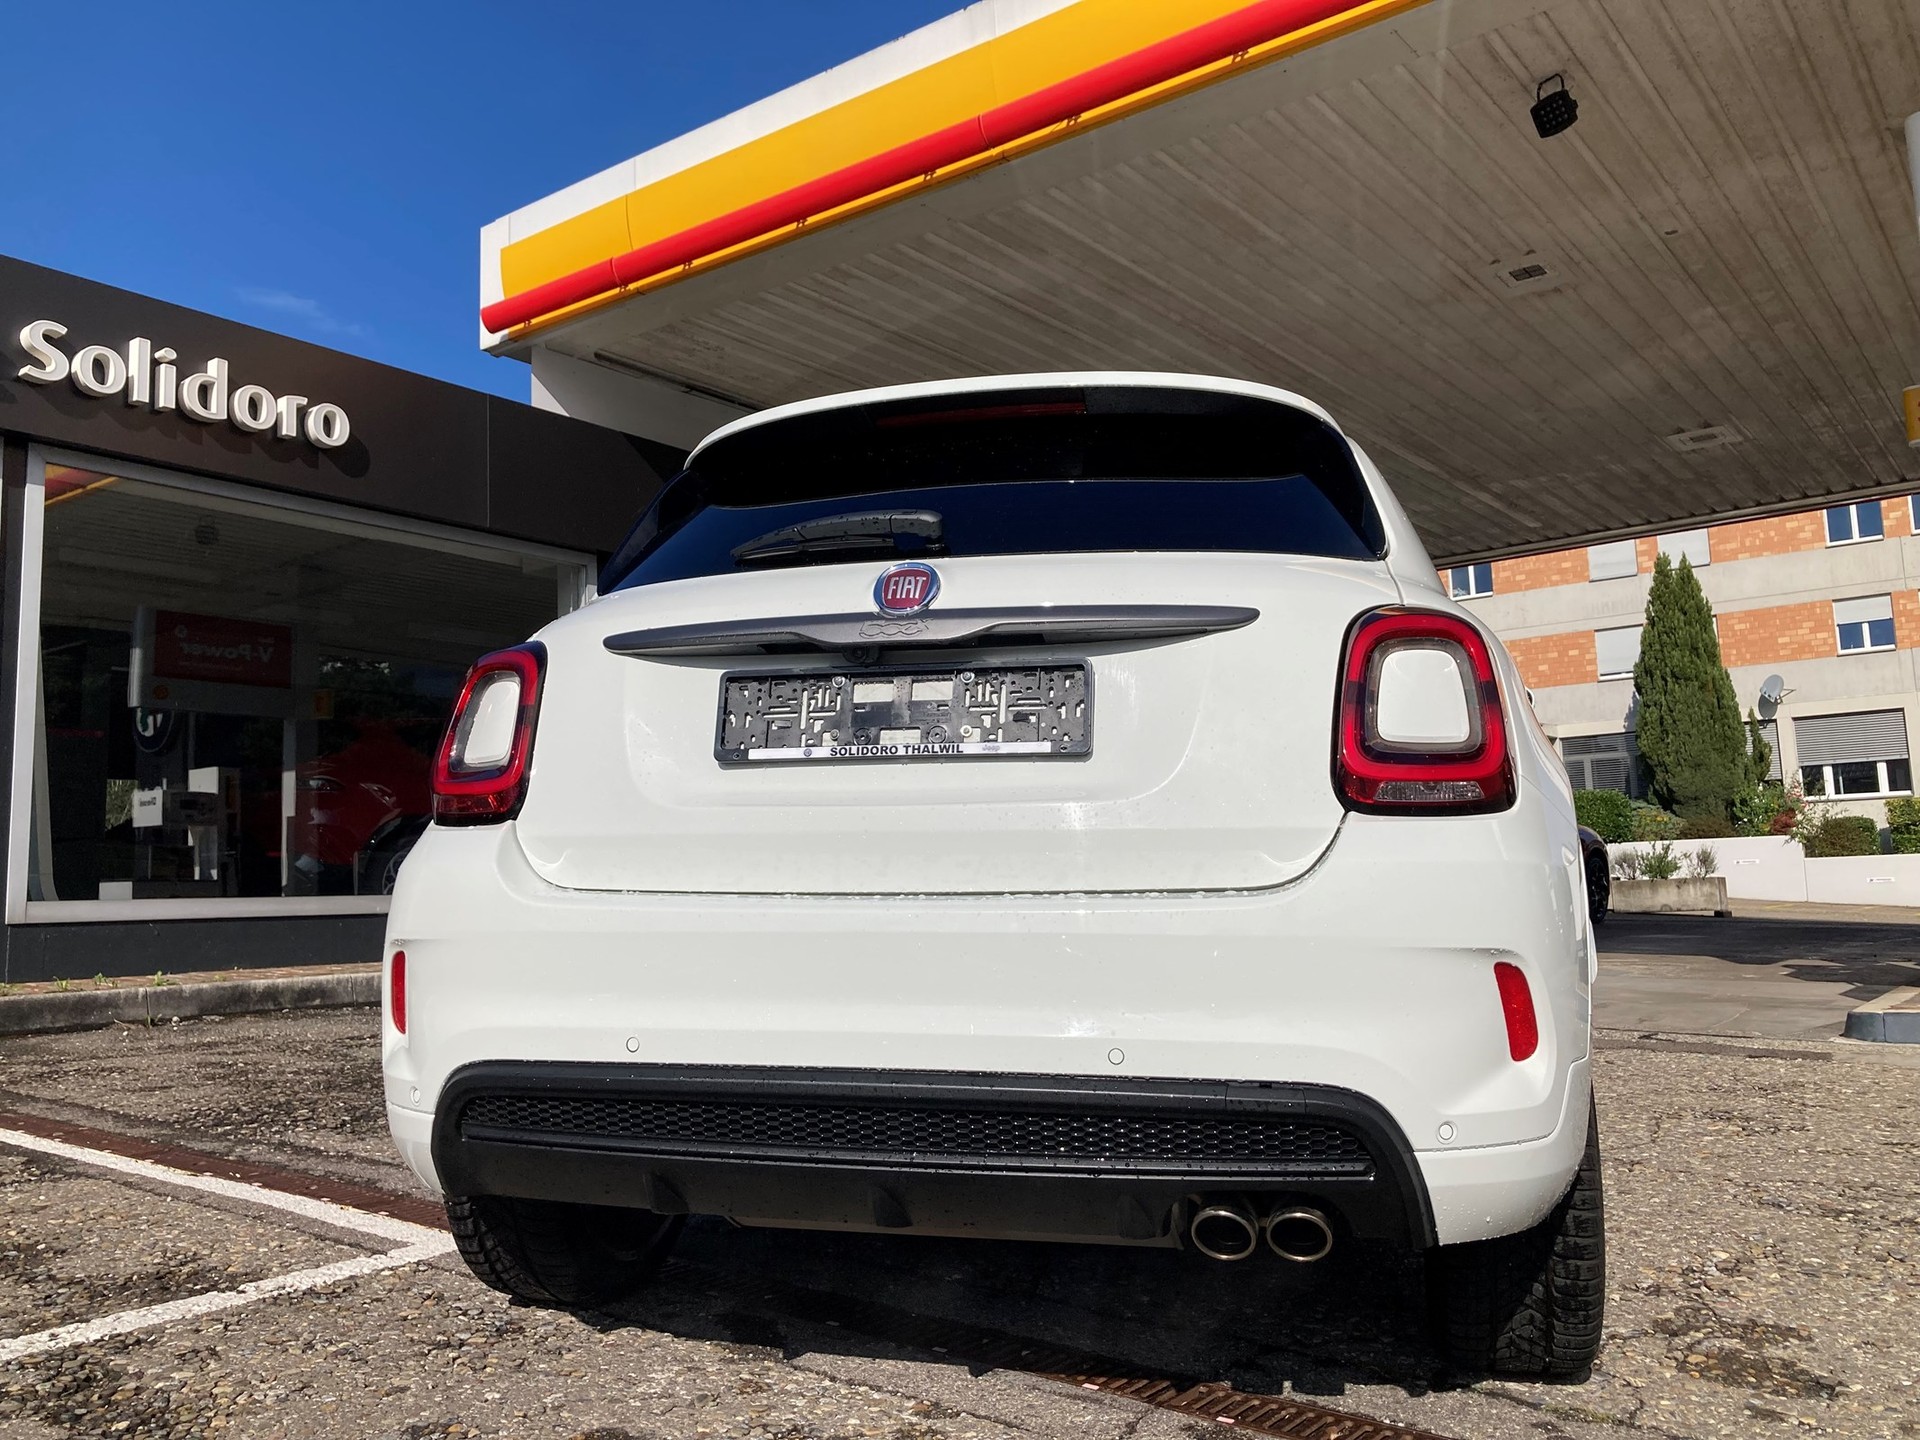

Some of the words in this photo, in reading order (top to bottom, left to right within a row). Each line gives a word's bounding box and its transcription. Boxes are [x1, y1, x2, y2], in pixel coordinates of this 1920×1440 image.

[18, 320, 350, 449] Solidoro
[887, 575, 927, 599] FIAT
[829, 745, 899, 757] SOLIDORO
[903, 743, 964, 755] THALWIL
